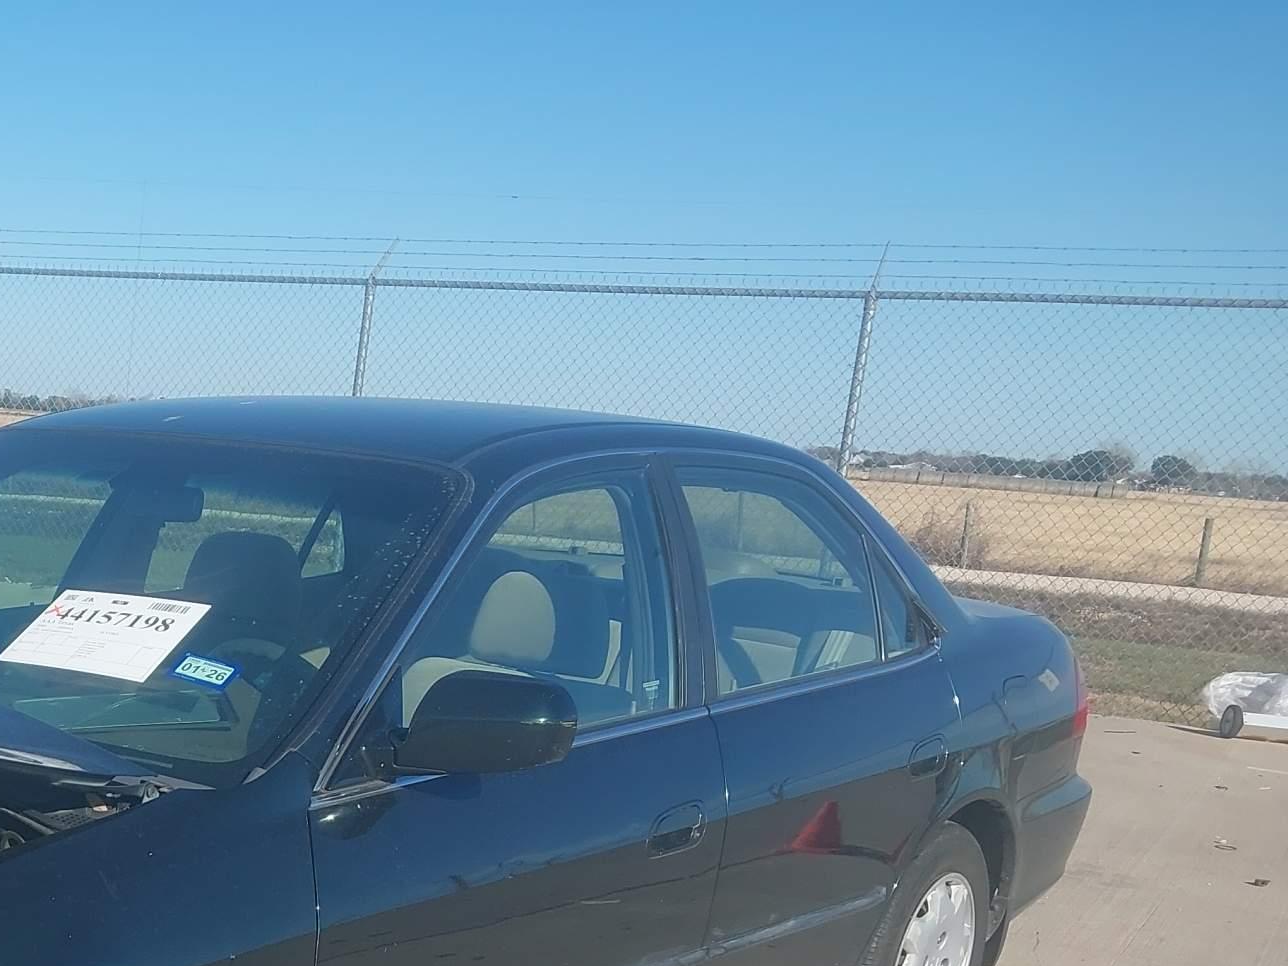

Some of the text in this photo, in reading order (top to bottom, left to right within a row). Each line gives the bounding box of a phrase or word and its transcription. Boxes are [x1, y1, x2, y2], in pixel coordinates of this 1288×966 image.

[56, 607, 175, 632] 44157198
[180, 662, 201, 674] 01
[205, 669, 228, 682] 26
